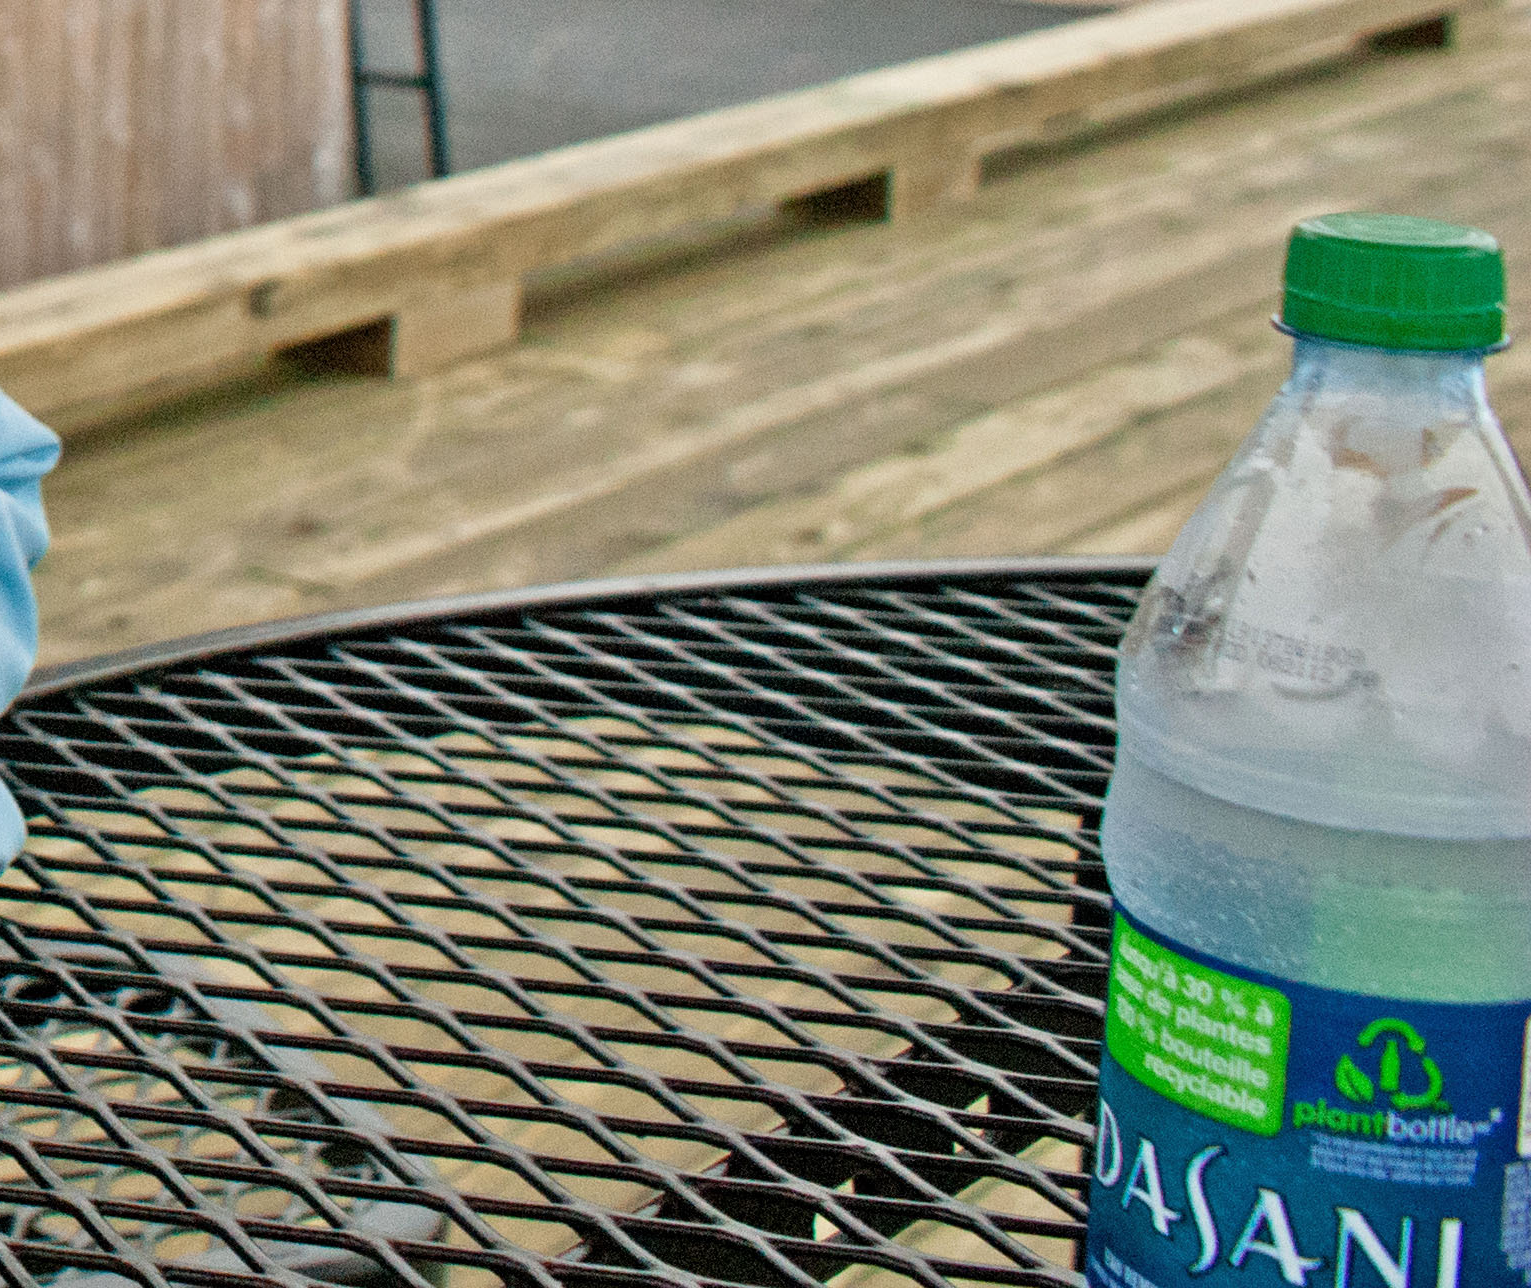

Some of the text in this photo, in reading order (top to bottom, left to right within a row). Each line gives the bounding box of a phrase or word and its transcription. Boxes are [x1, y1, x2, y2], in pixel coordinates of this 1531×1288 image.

[1147, 987, 1172, 1017] de
[1176, 1005, 1272, 1057] plantes
[1182, 974, 1214, 1005] 30
[1221, 988, 1249, 1018] %
[1255, 999, 1274, 1027] à
[1144, 1052, 1267, 1118] recyclable
[1160, 1026, 1269, 1089] bouteille
[1095, 1096, 1465, 1288] DASANI
